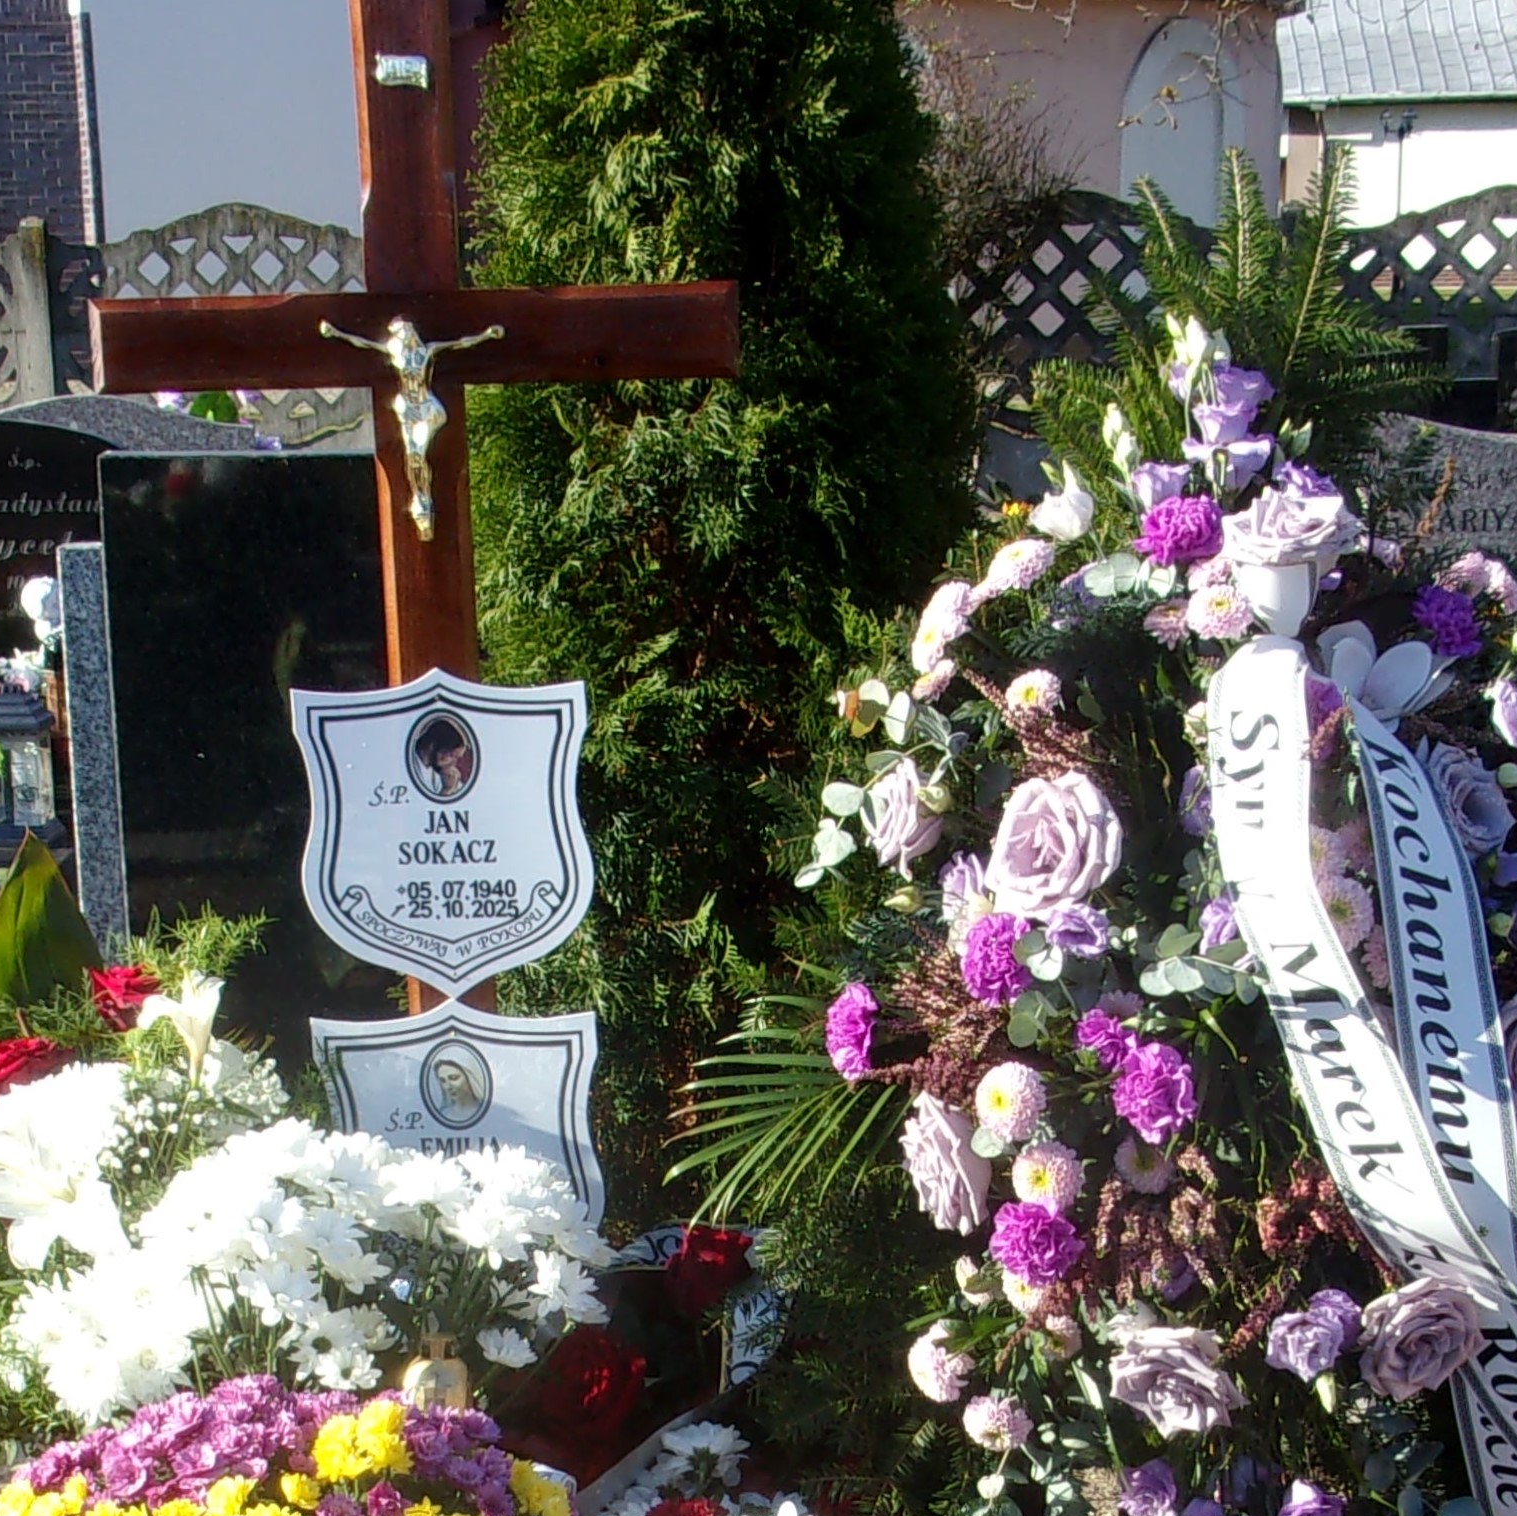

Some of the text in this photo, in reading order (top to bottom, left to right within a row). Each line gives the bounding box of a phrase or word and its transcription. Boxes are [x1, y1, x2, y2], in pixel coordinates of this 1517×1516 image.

[368, 781, 410, 807] Ś.P.
[424, 810, 470, 834] JAN
[398, 839, 497, 865] SOKACZ
[406, 878, 517, 901] 05.07.1940
[407, 899, 520, 919] 25.10.2025
[355, 907, 545, 958] SPOCZYWAJ W POKOJU
[1363, 734, 1475, 1185] Kochanemu
[1270, 942, 1402, 1184] Marek
[384, 1107, 426, 1132] Ś.P.
